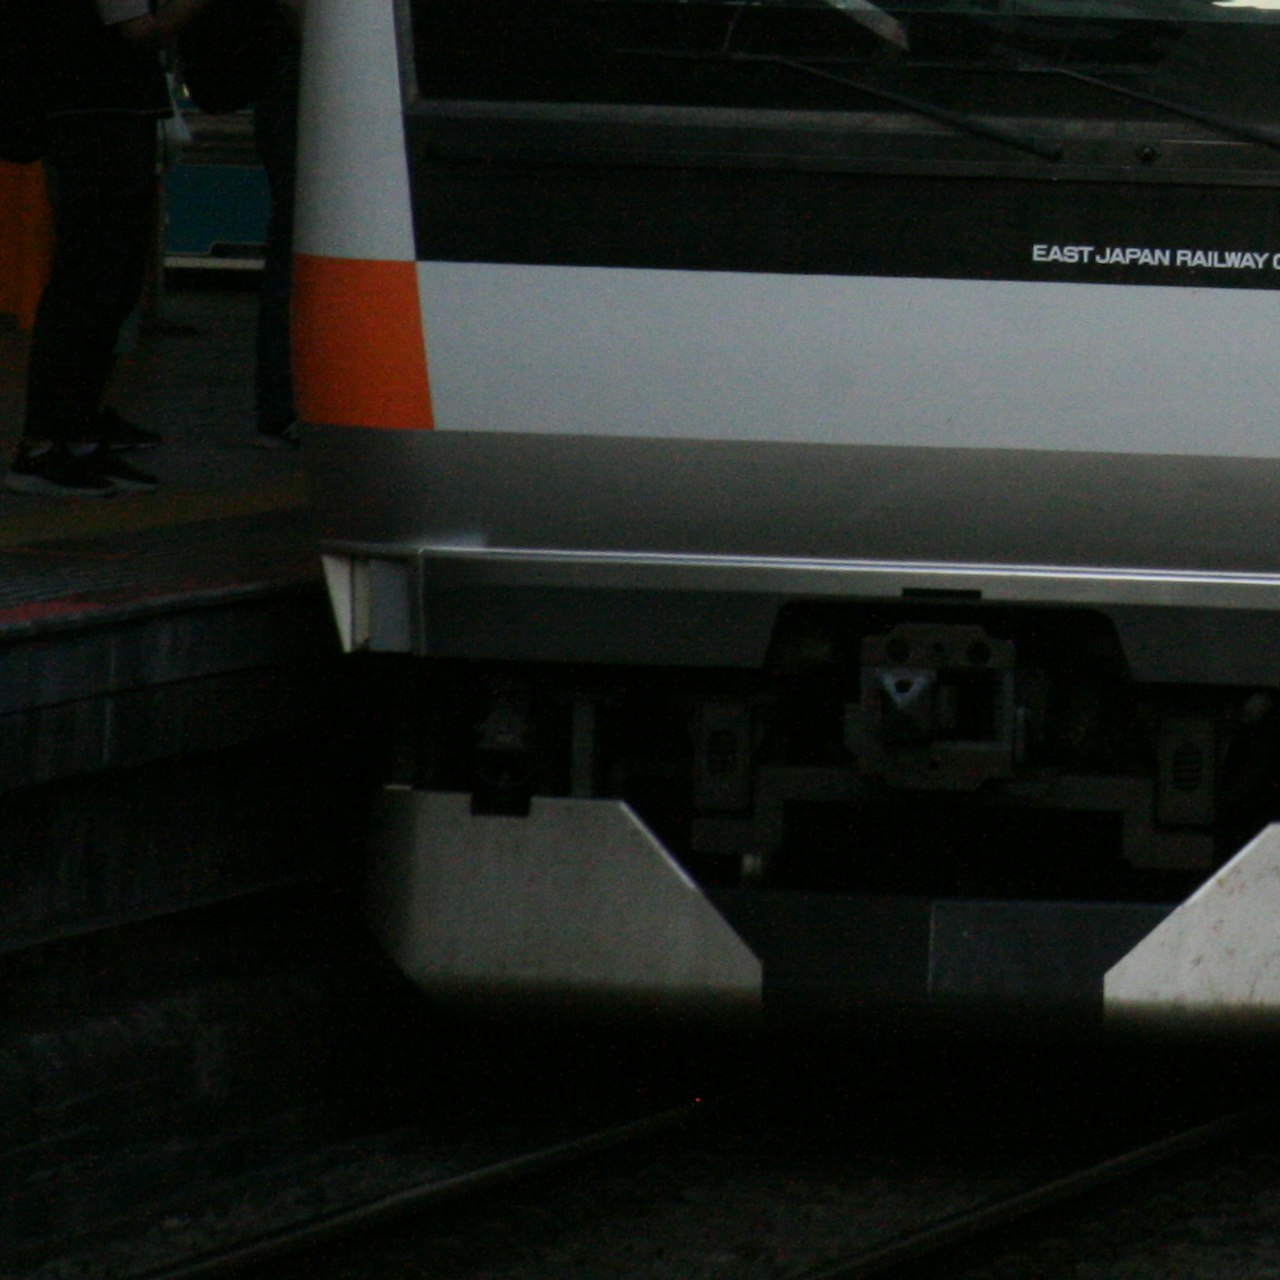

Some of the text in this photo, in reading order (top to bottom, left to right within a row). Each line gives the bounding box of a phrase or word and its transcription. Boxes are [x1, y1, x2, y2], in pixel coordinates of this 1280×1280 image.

[1032, 244, 1093, 263] EAST
[1095, 246, 1169, 267] JAPAN
[1176, 250, 1269, 270] RAILWAY
